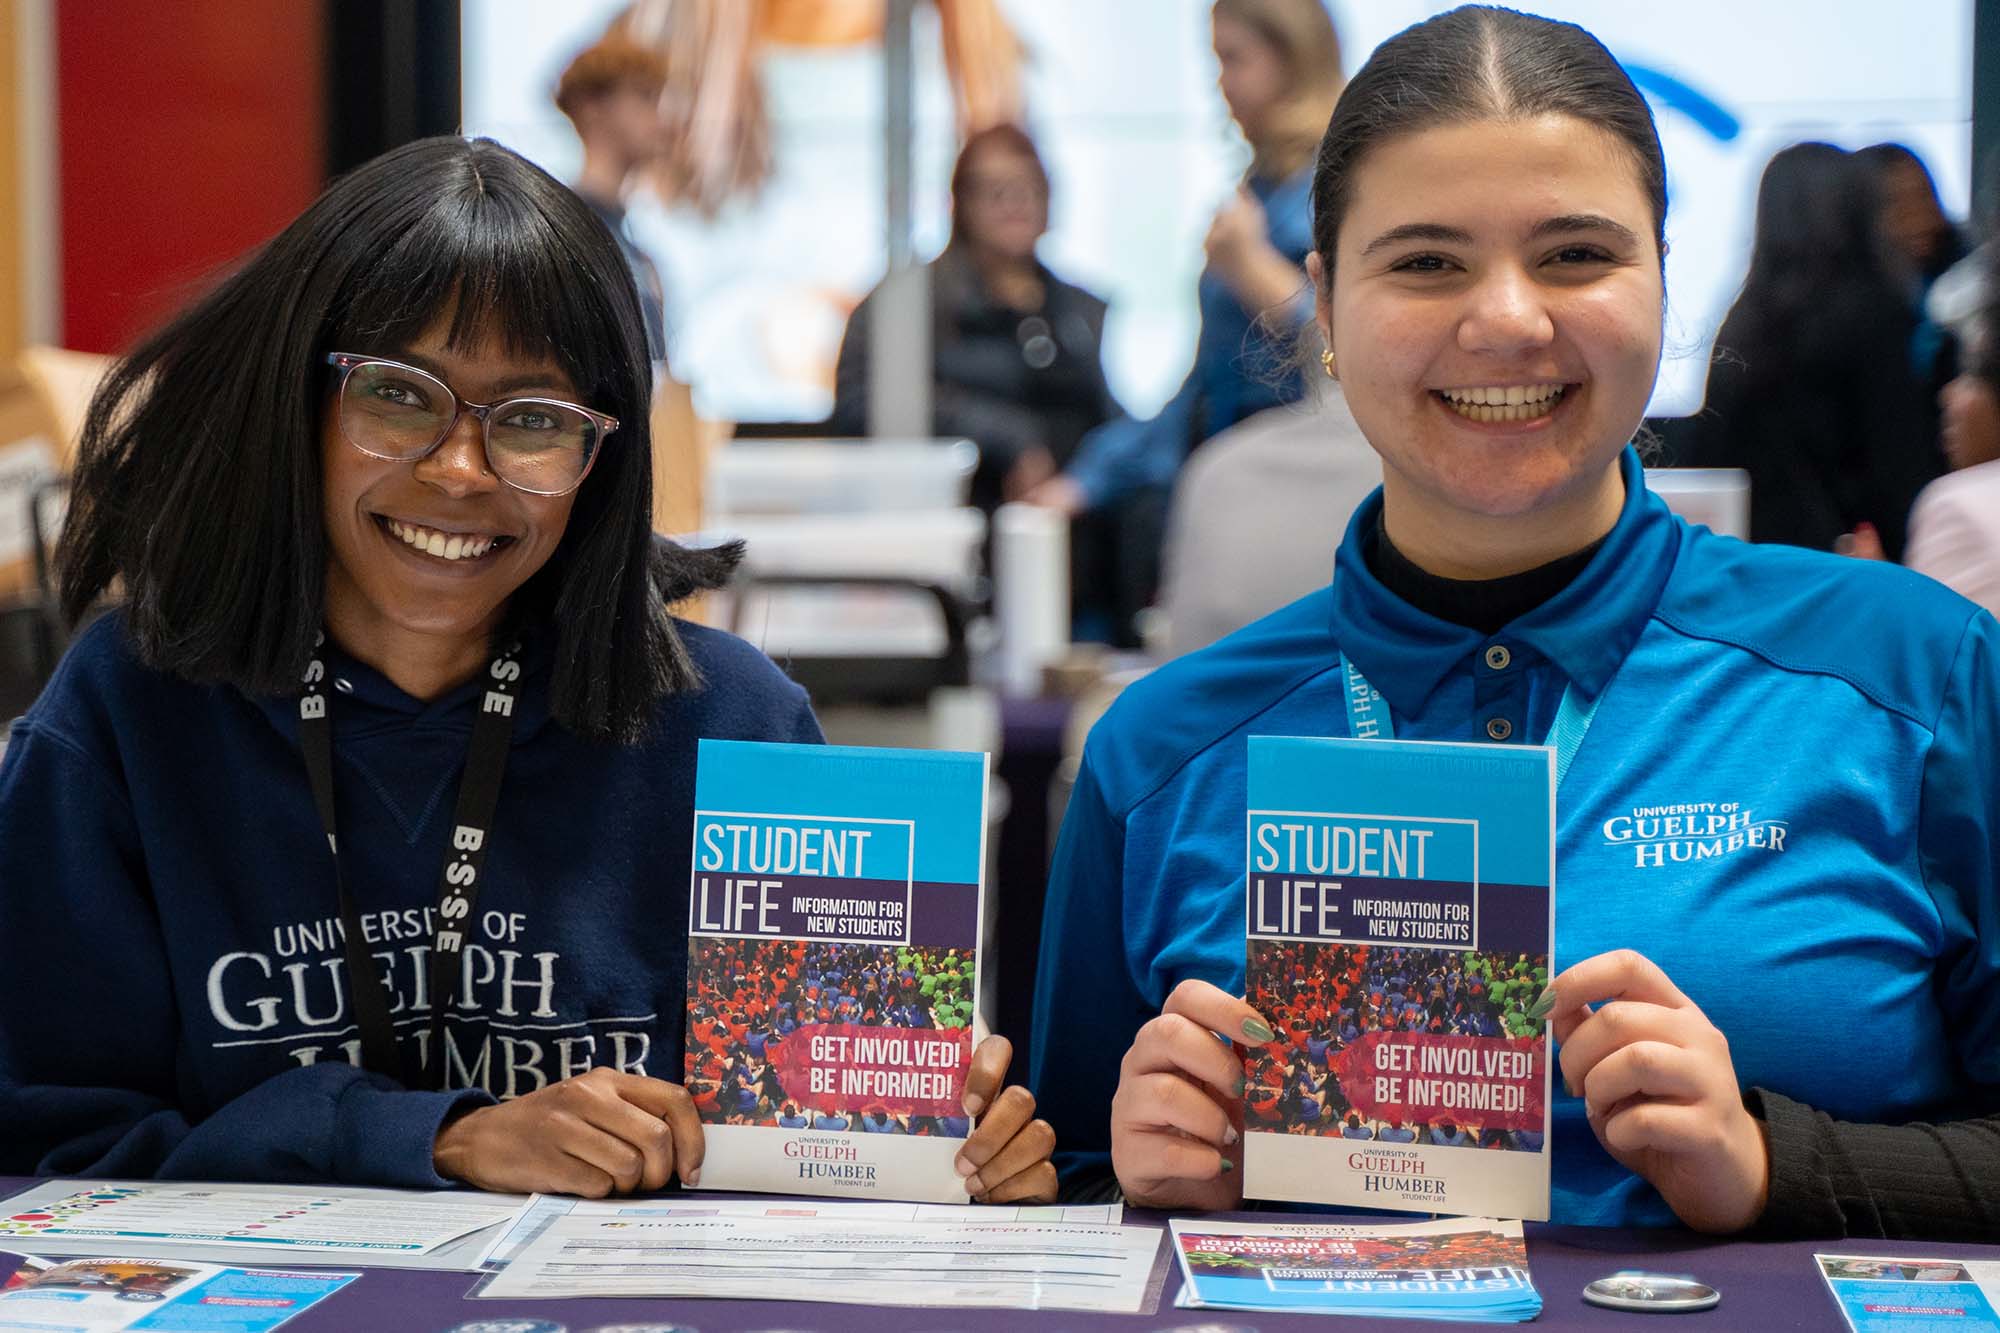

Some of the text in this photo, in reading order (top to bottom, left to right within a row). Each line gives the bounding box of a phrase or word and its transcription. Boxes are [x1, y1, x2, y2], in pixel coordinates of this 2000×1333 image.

[1633, 802, 1740, 817] UNIVERSITY OF
[1603, 810, 1751, 841] GUELPH
[701, 823, 872, 877] STUDENT
[1256, 823, 1433, 879] STUDENT
[1634, 826, 1787, 868] HUMBER
[700, 878, 783, 933] LIFE
[792, 896, 903, 918] INFORMATION FOR
[1256, 879, 1342, 936] LIFE
[1353, 899, 1470, 921] INFORMATION FOR
[482, 911, 527, 943] OF
[807, 916, 903, 937] NEW STUDENTS
[1369, 919, 1470, 941] NEW STUDENTS
[810, 1035, 960, 1068] GET INVOLVED!
[1375, 1043, 1533, 1080] GET INVOLVED!
[810, 1067, 953, 1100] BE INFORMED!
[1375, 1076, 1525, 1112] BE INFORMED!
[784, 1141, 857, 1161] GUELPH
[798, 1137, 839, 1145] UNIVERSITY
[1348, 1153, 1425, 1174] GUELPH
[1363, 1149, 1418, 1159] UNIVERSITY OF
[799, 1162, 876, 1180] HUMBER
[834, 1179, 863, 1187] STUDENT
[1364, 1175, 1446, 1194] HUMBER
[1401, 1193, 1446, 1203] STUDENT LIFE
[1195, 1245, 1310, 1255] INVOLVED!
[1200, 1239, 1320, 1249] INFORMED!
[1322, 1279, 1510, 1292] STUDENT
[1411, 1269, 1504, 1281] LIFE
